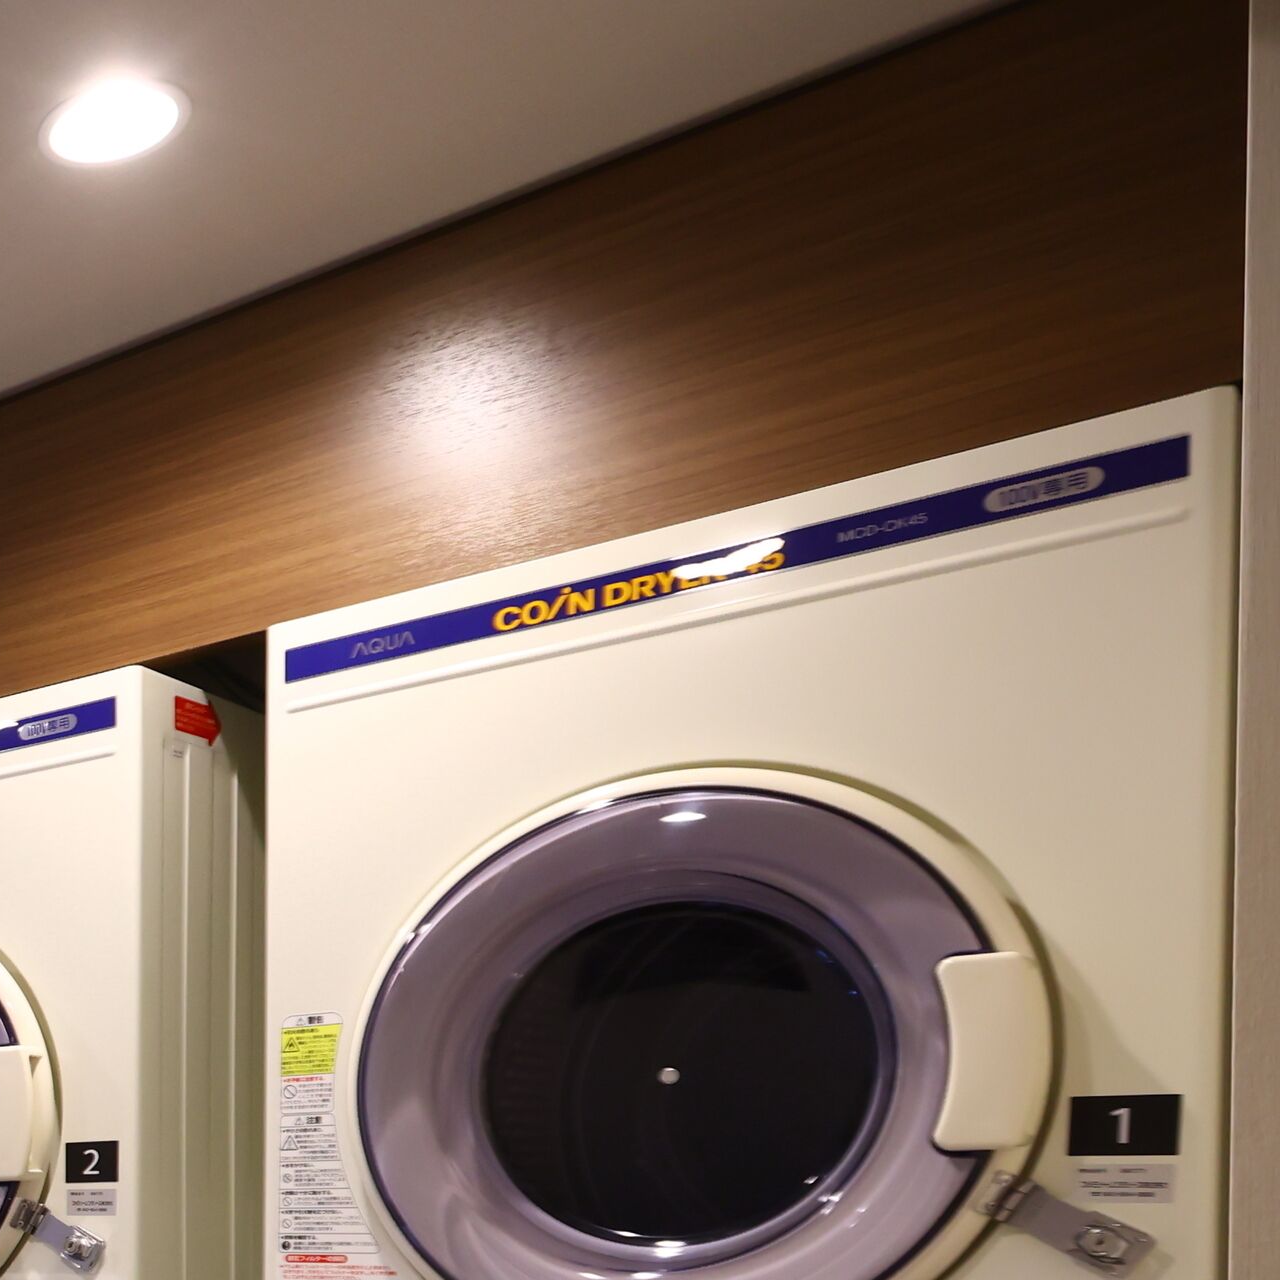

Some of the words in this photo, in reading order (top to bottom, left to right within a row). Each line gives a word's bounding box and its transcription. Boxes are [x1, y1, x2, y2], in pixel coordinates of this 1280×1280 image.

[492, 585, 595, 632] COIN
[349, 629, 416, 660] AQUA
[1108, 1107, 1131, 1144] 1
[83, 1148, 100, 1175] 2
